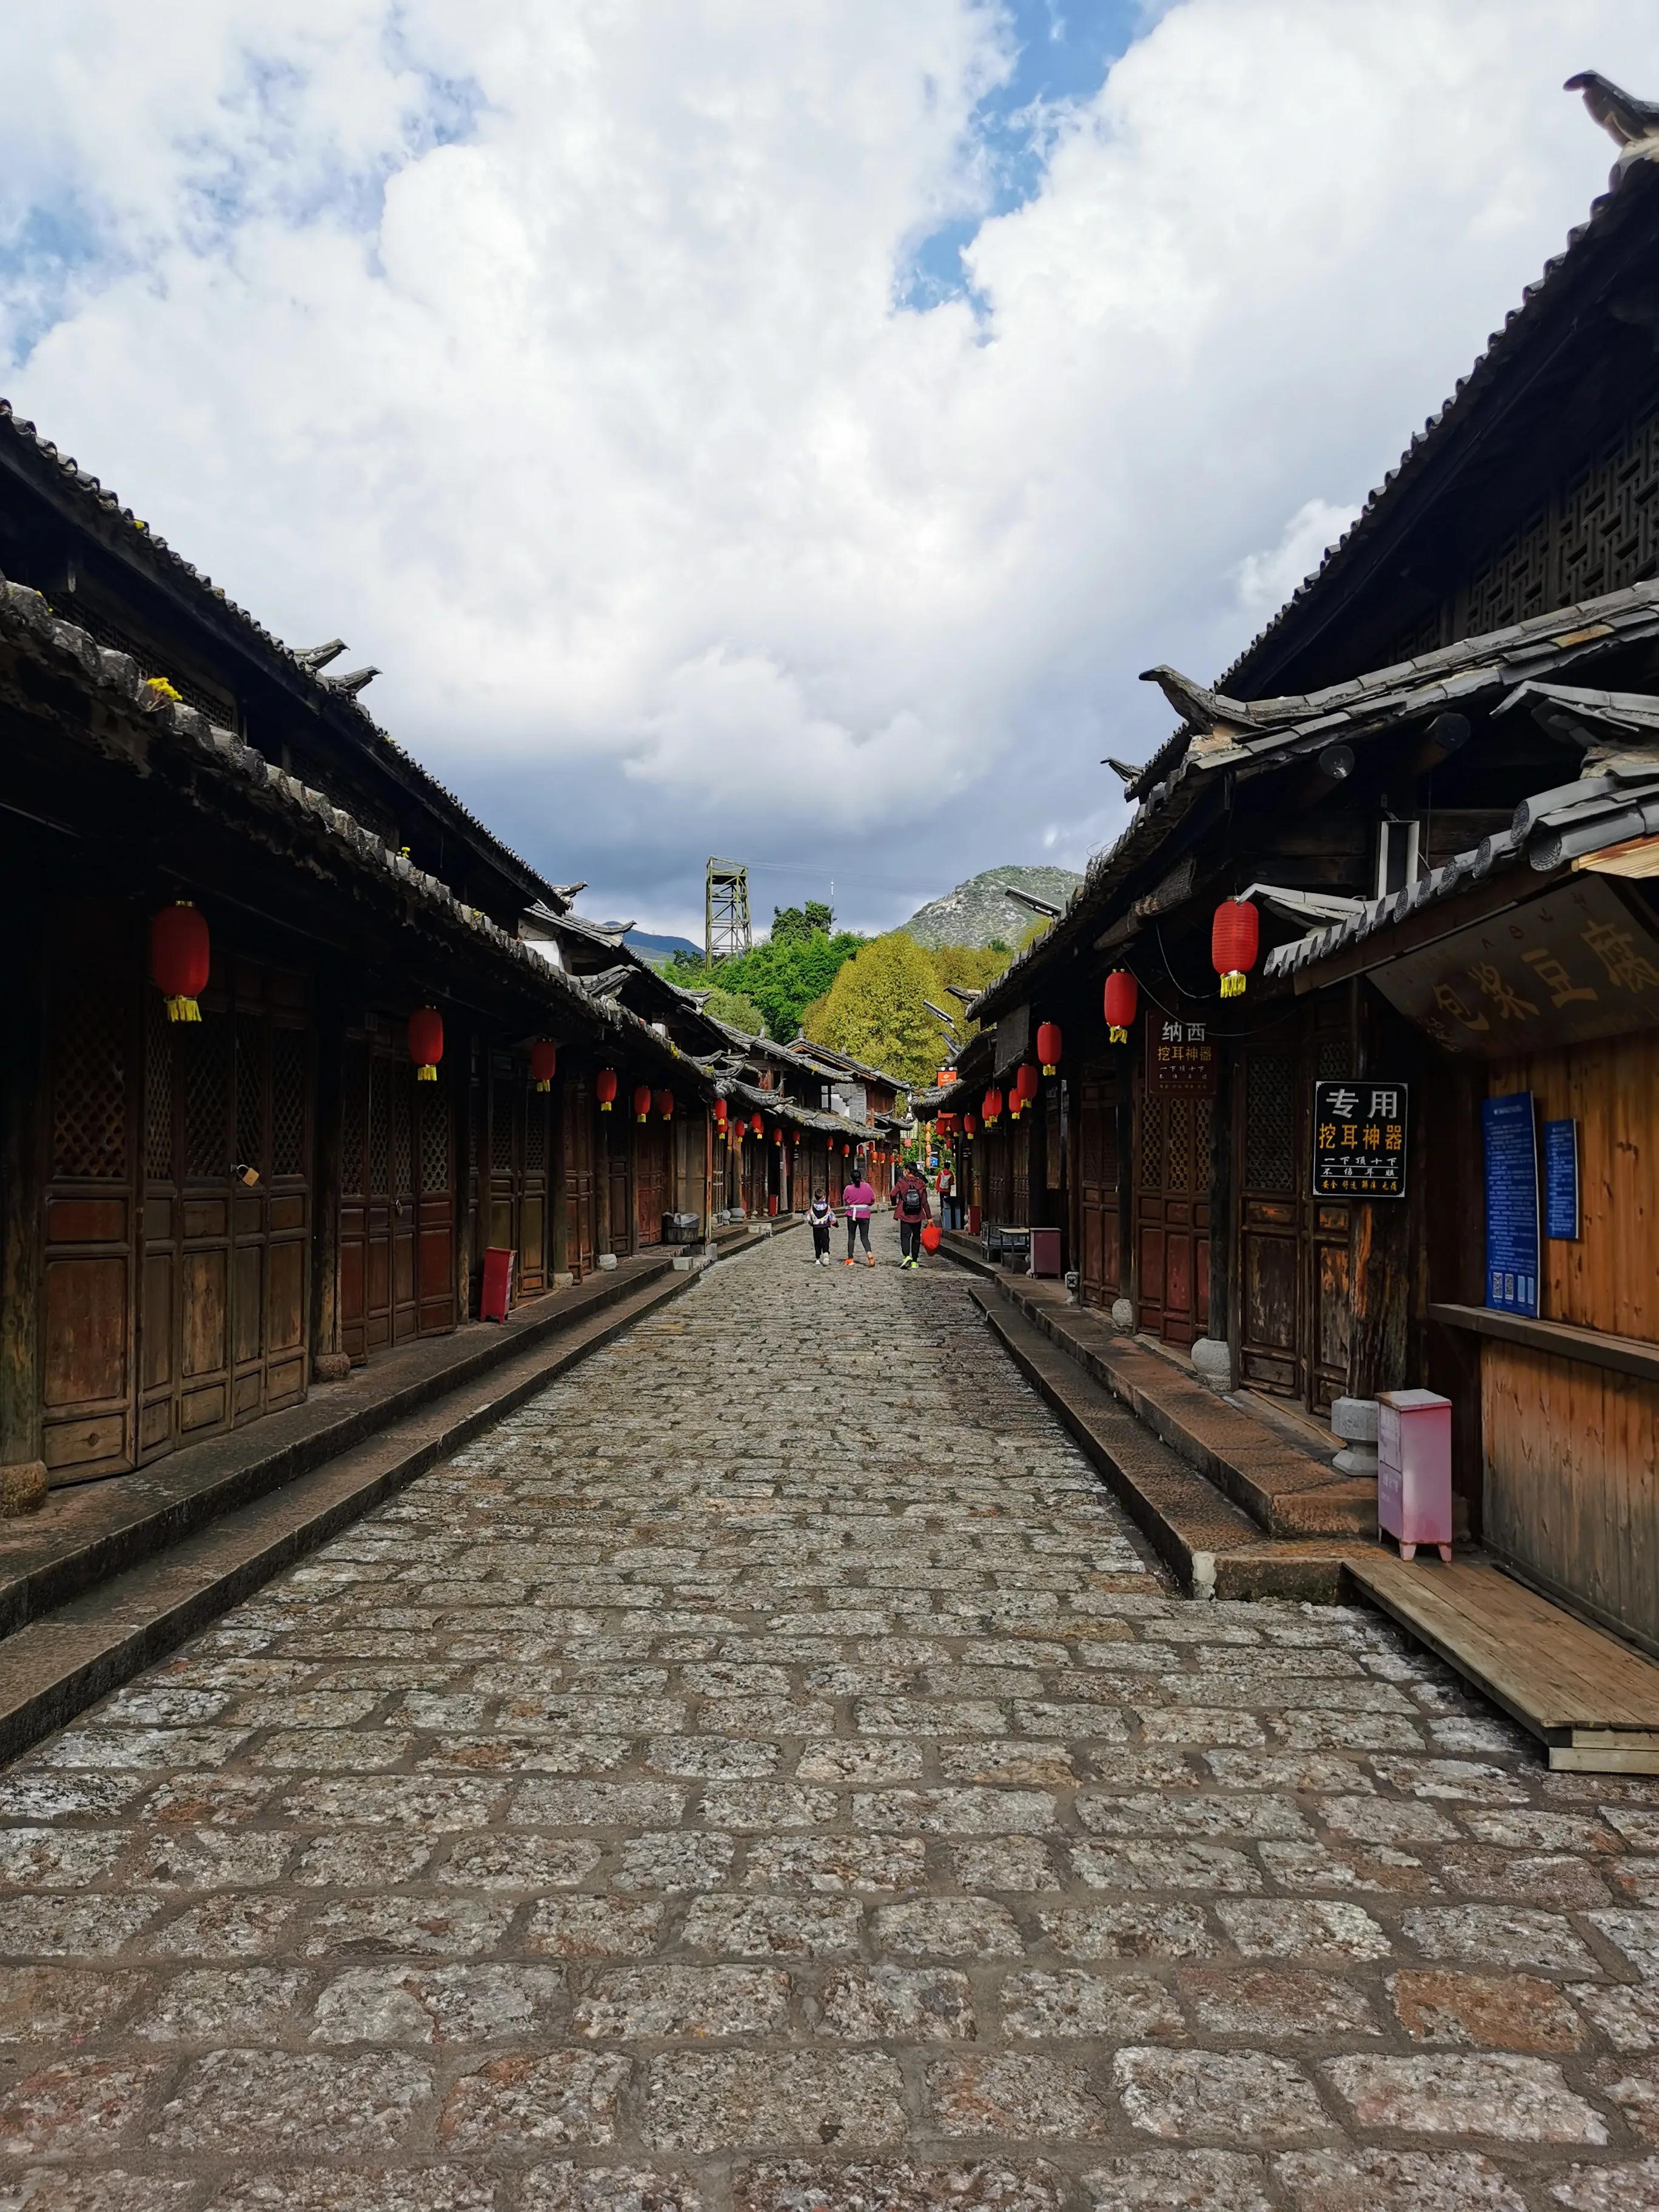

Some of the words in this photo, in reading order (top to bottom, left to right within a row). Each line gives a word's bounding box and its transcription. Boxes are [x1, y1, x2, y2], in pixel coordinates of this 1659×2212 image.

[1161, 1021, 1207, 1042] 纳西
[1157, 1046, 1212, 1062] 挖耳神器
[1326, 1088, 1397, 1119] 专用
[1319, 1122, 1402, 1150] 挖耳神器
[1324, 1156, 1397, 1166] 一下顶十下
